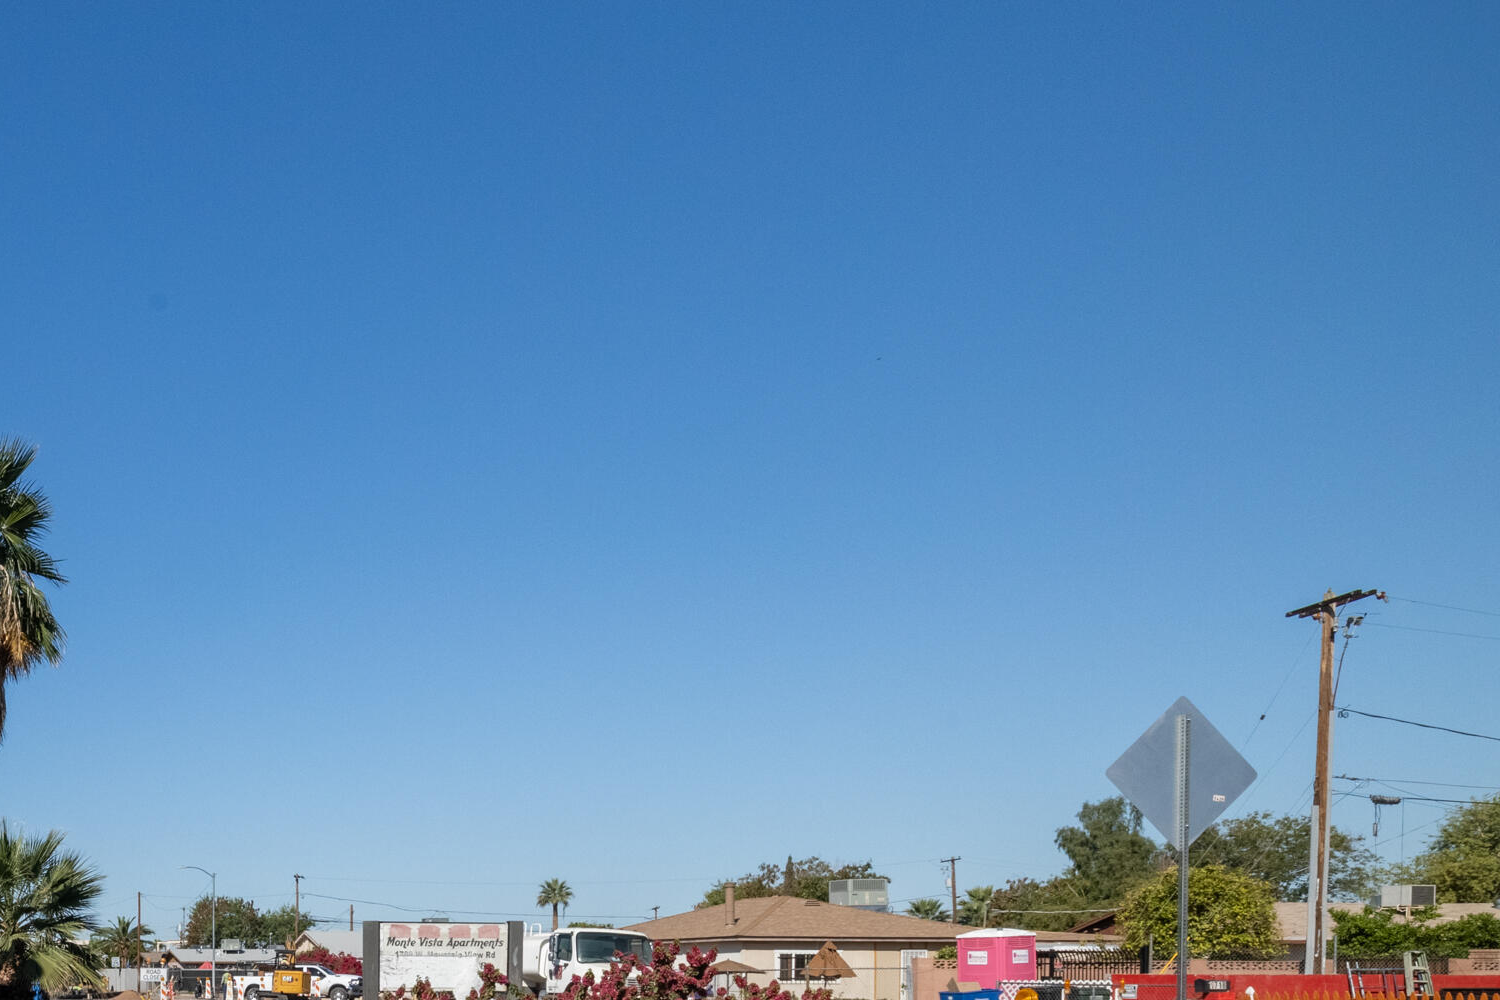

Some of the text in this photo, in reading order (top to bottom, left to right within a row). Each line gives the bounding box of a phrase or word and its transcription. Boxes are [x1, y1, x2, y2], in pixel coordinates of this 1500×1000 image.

[386, 937, 504, 949] Monte Vista Apartments
[485, 951, 496, 959] Rd
